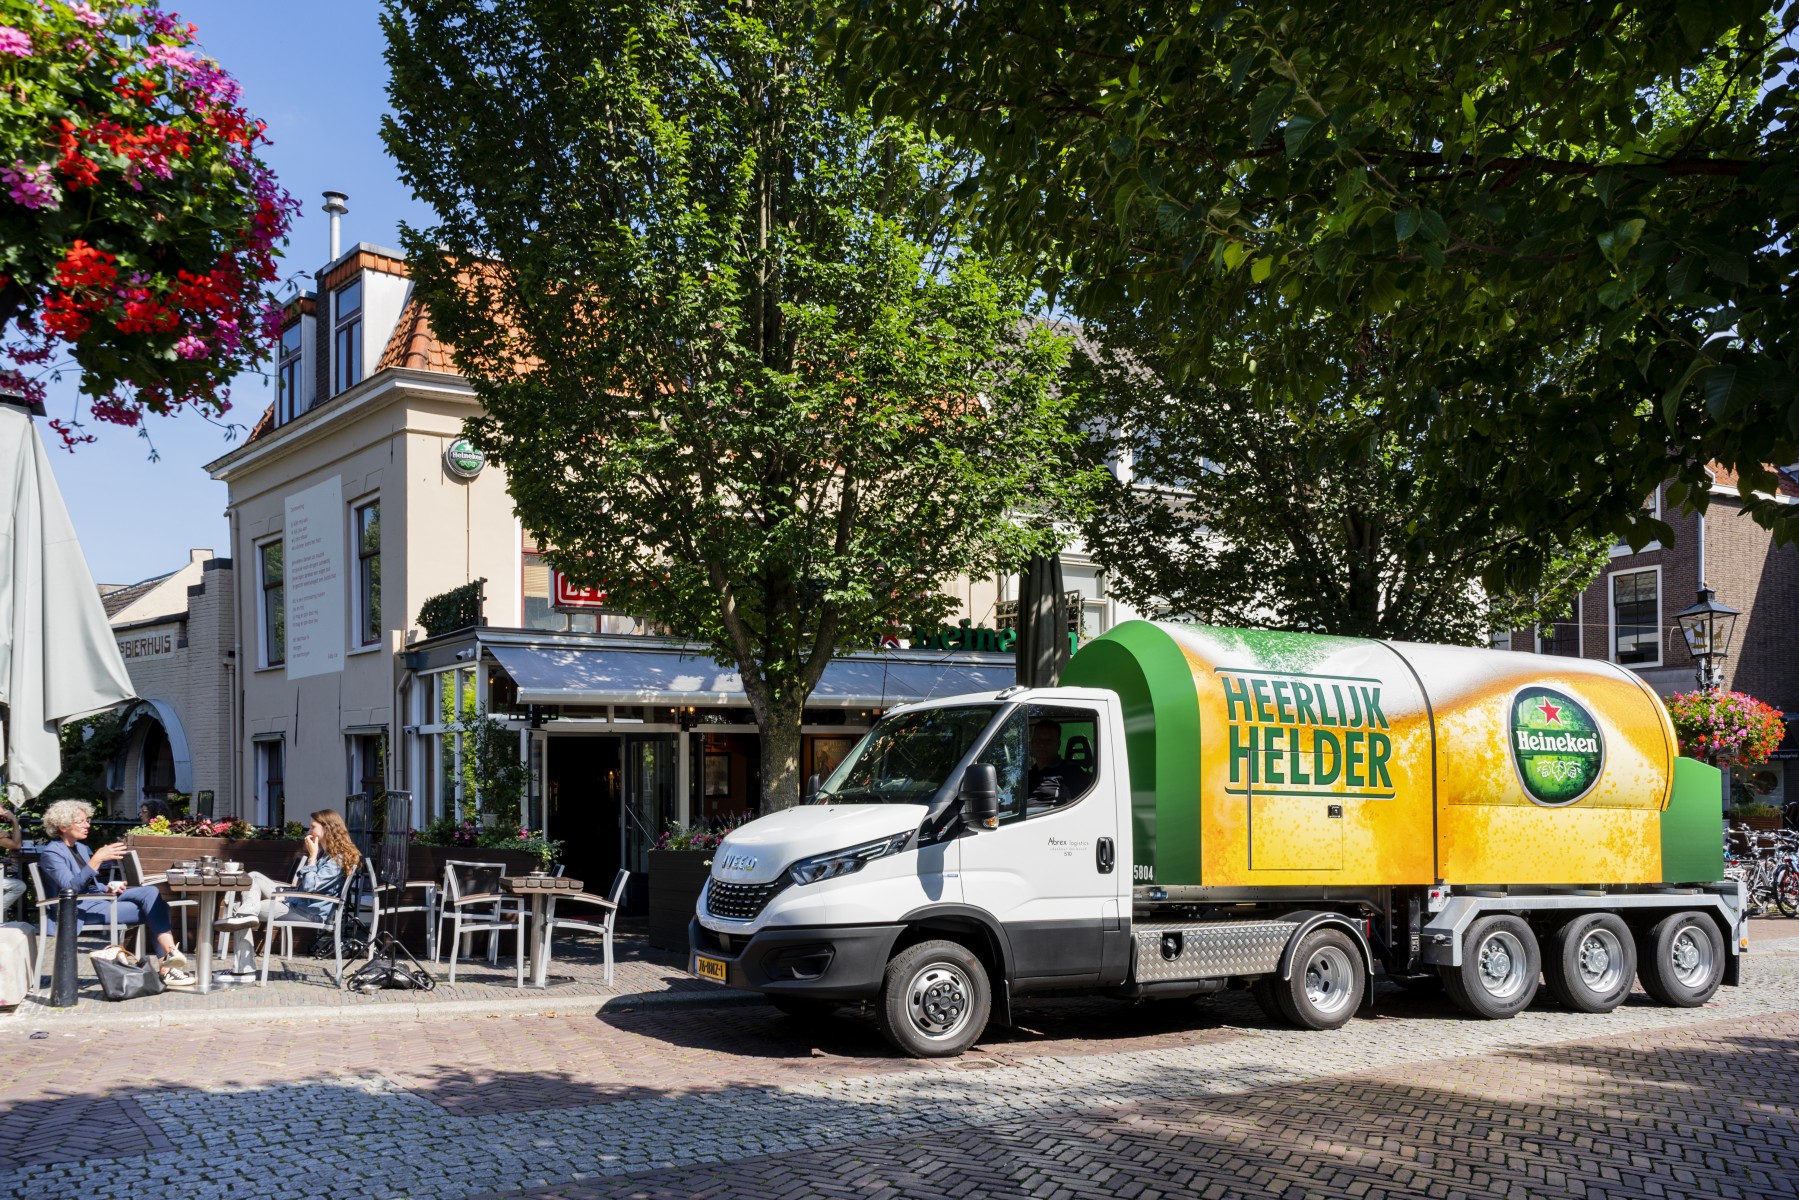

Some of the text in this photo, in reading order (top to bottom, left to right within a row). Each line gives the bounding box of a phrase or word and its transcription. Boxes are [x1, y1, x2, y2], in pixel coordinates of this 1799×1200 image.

[125, 635, 171, 658] BIERHUIS
[1221, 676, 1390, 730] HEERLIJK
[1516, 731, 1598, 753] Heineken
[1229, 725, 1393, 788] HELDER
[722, 855, 757, 871] IVECO
[1133, 864, 1154, 881] 5804
